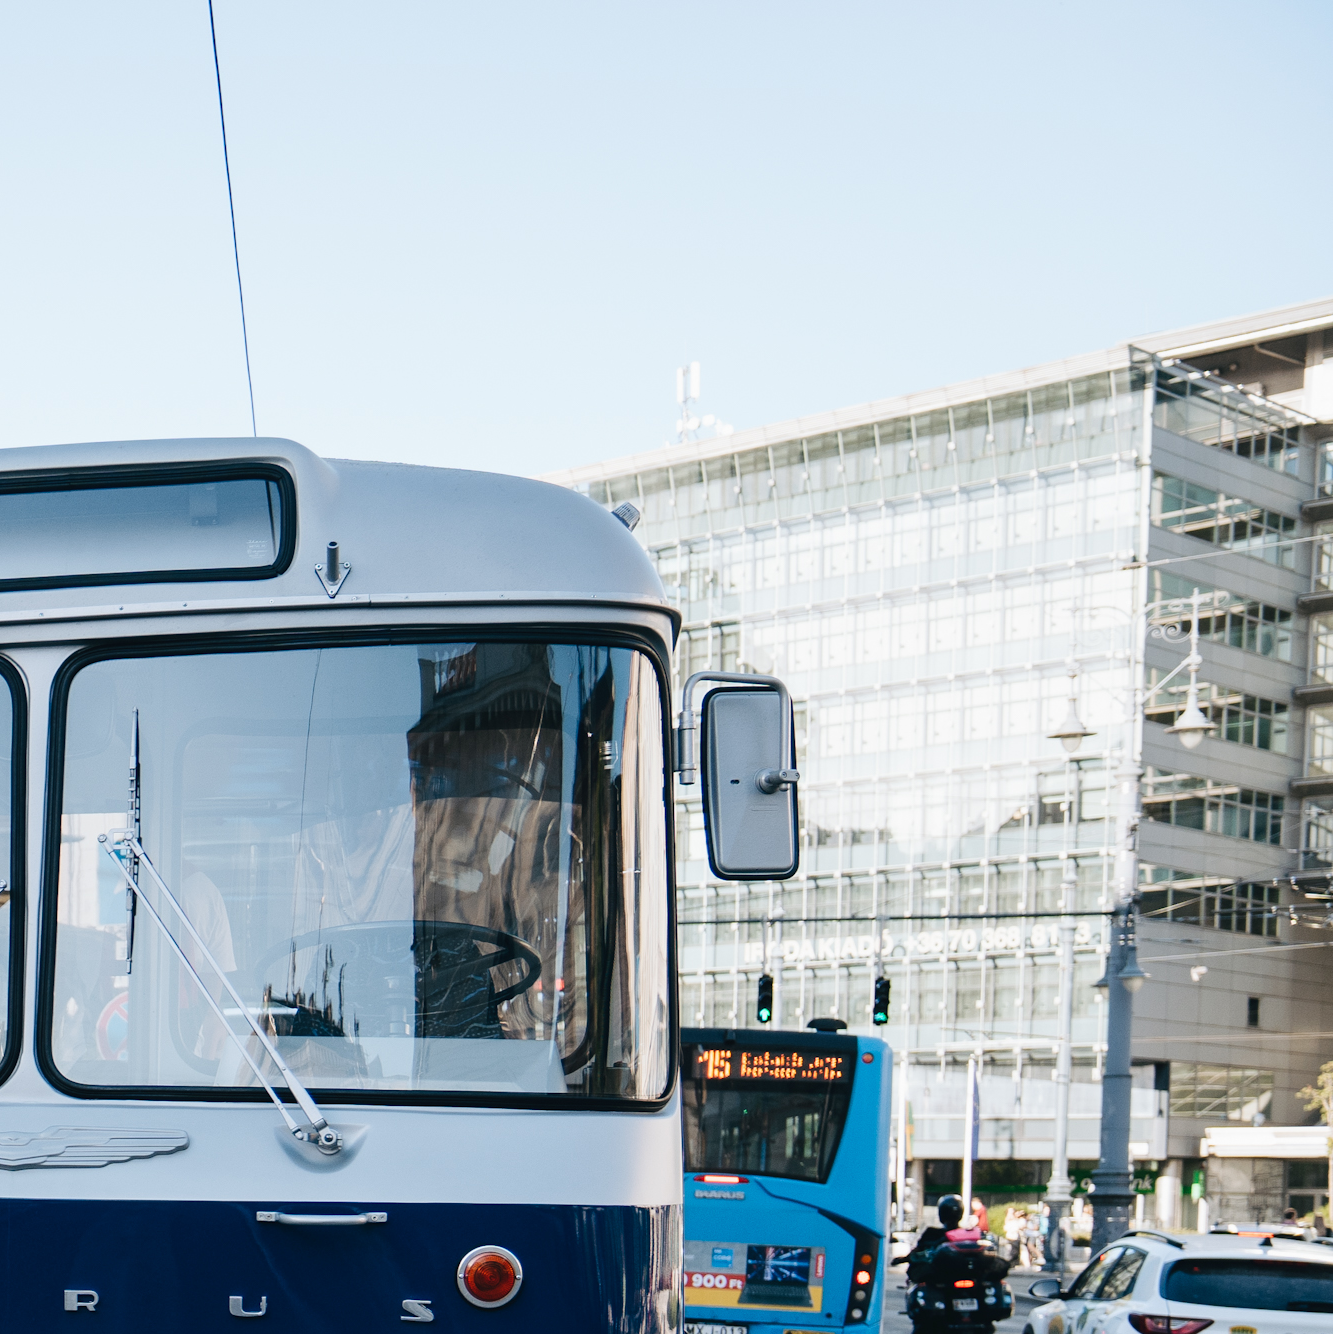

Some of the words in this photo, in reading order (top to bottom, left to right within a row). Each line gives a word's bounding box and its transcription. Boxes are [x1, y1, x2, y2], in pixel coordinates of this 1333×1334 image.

[947, 927, 977, 951] 70
[980, 924, 1021, 950] 368
[1031, 921, 1091, 948] 813
[692, 1274, 727, 1289] 900
[729, 1279, 743, 1289] Ft
